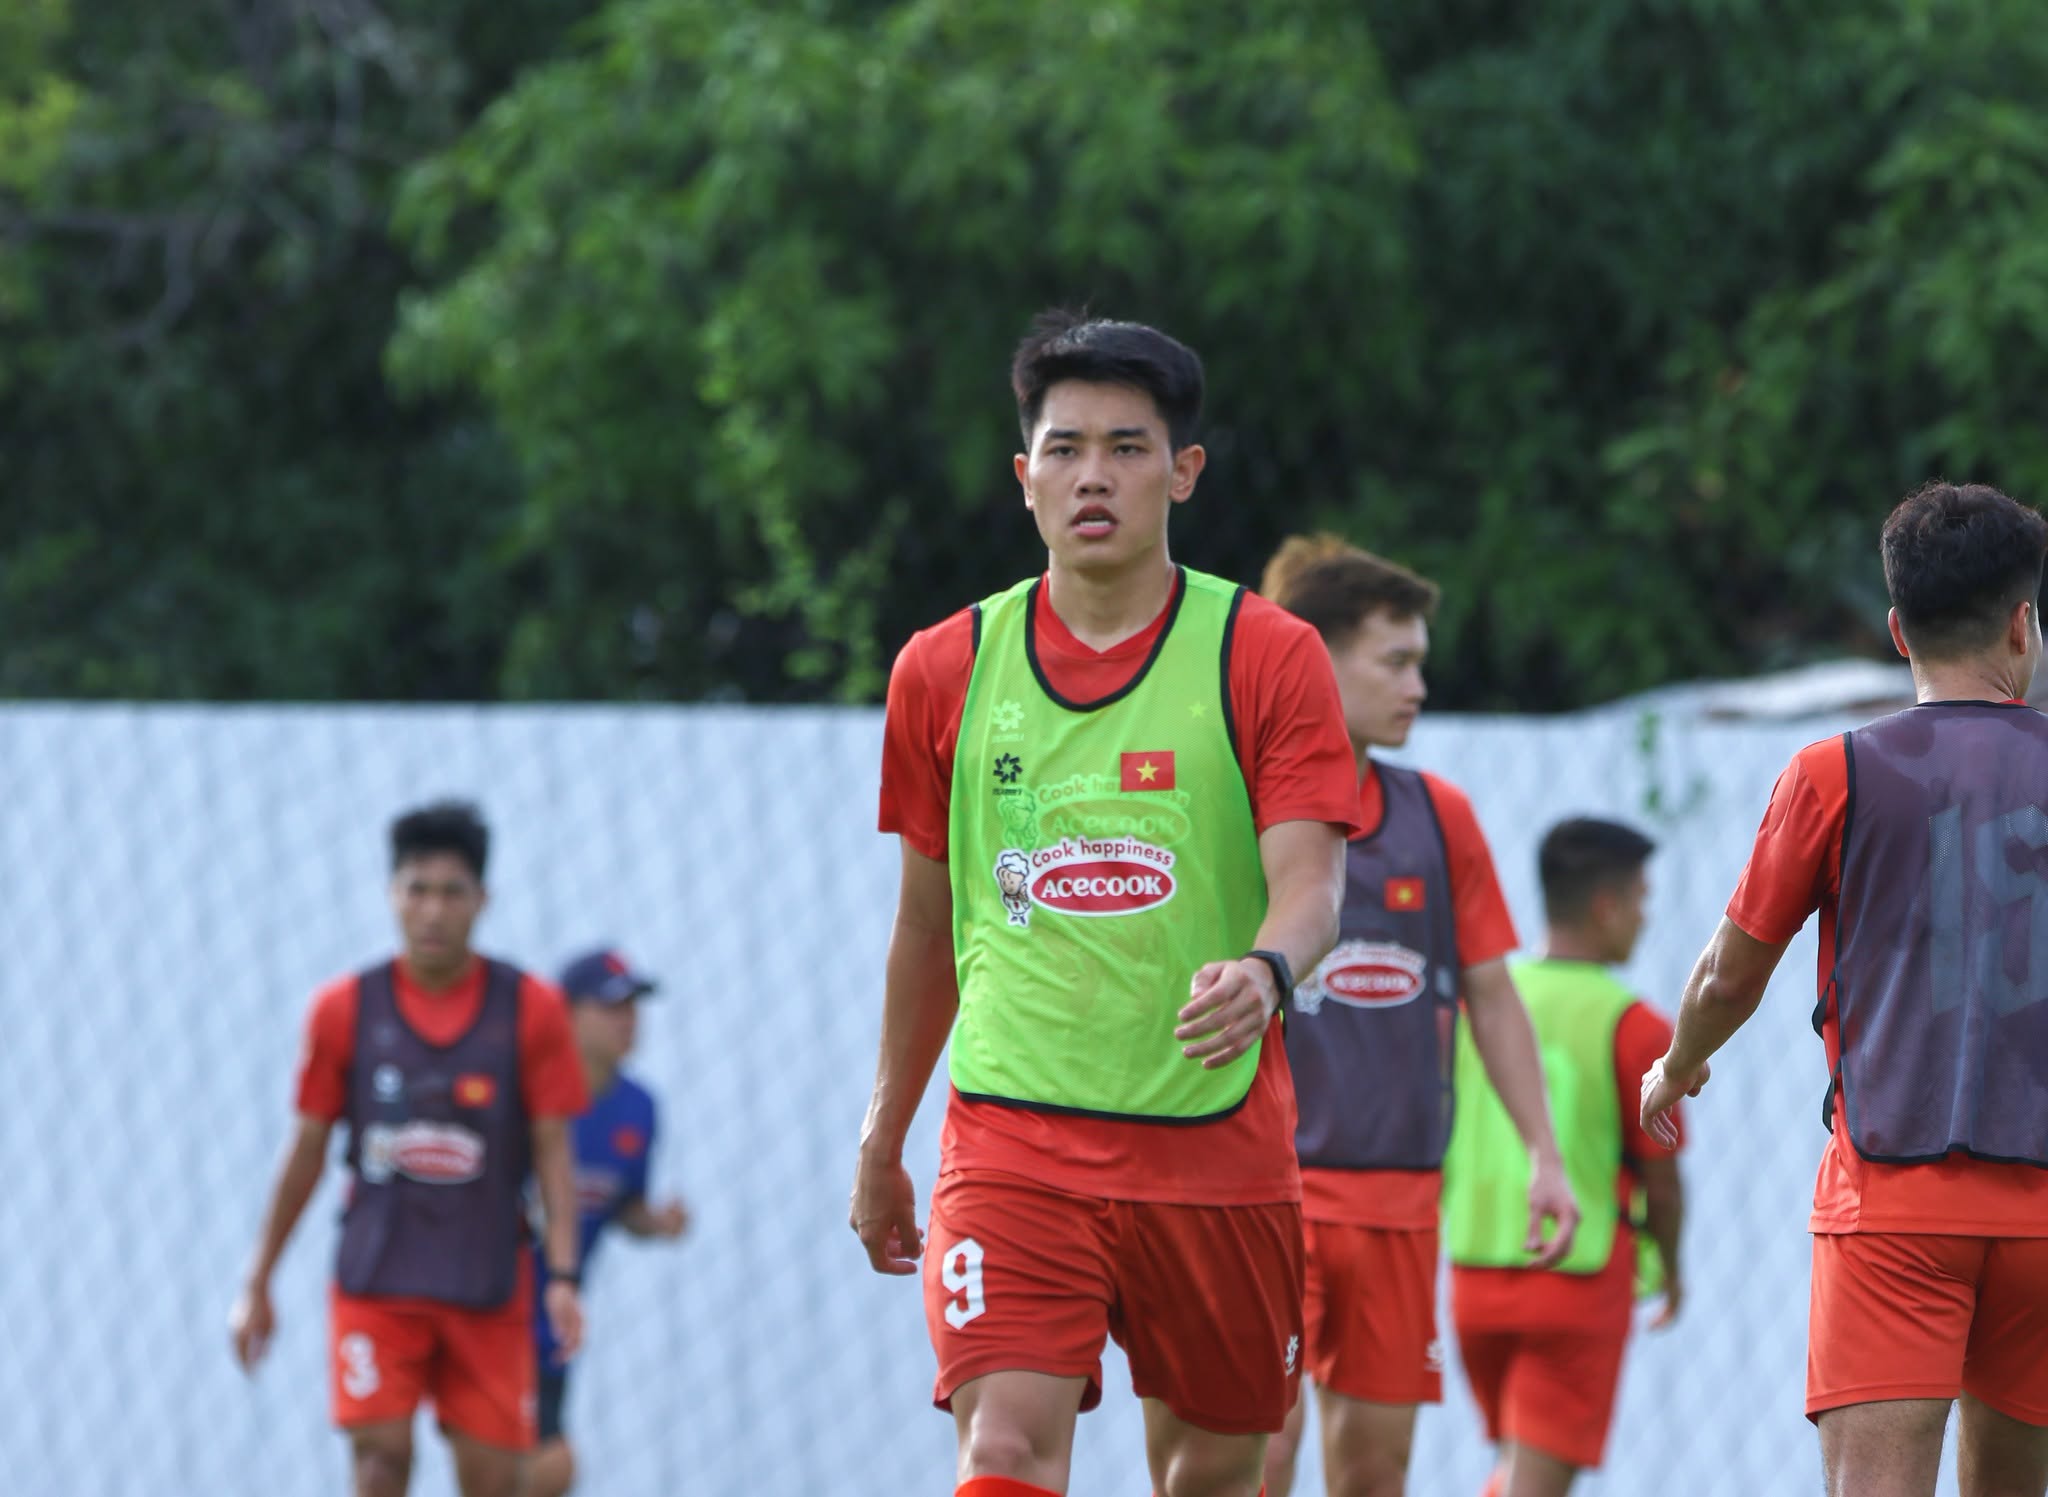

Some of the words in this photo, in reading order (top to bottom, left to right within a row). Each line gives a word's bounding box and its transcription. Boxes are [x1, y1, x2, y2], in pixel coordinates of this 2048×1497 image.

[1032, 841, 1075, 868] Cook
[1080, 838, 1171, 866] happiness
[942, 1238, 987, 1331] 9
[340, 1332, 382, 1400] 3
